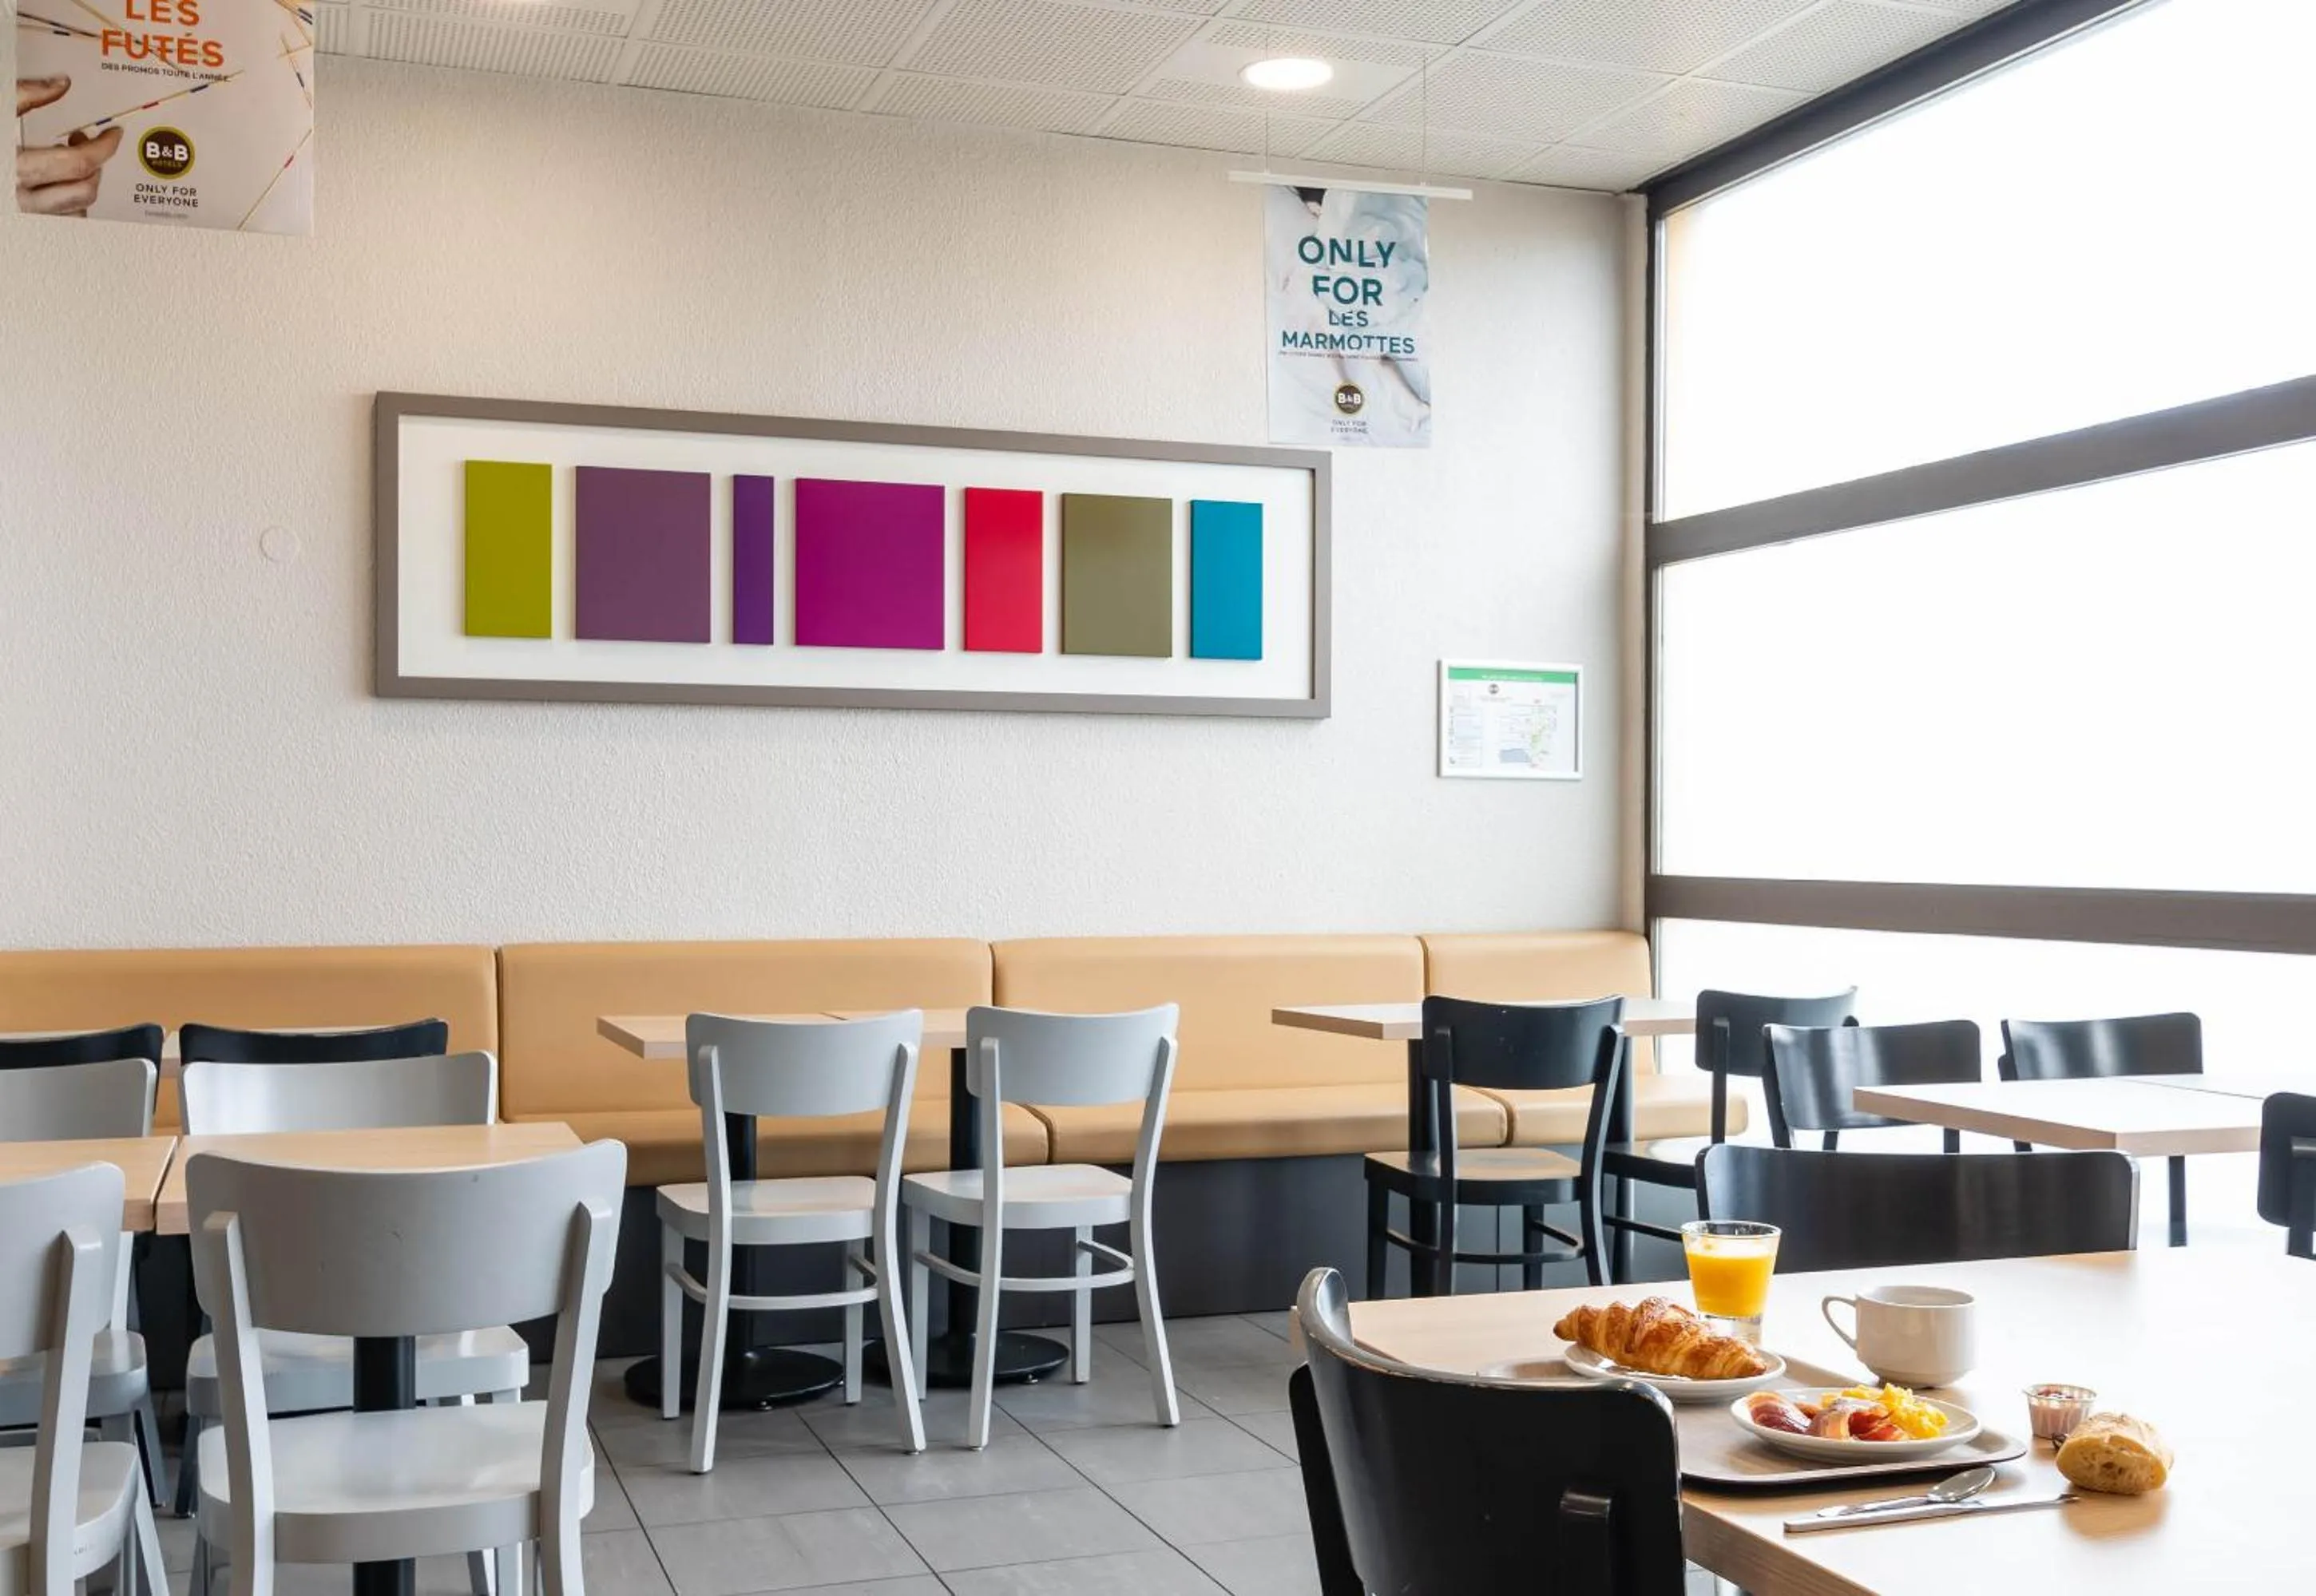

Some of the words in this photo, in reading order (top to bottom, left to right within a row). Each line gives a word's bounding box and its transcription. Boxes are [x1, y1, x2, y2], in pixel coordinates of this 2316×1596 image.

[126, 0, 200, 26] LES
[101, 28, 224, 68] FUTÉS
[101, 62, 119, 71] DES
[121, 65, 160, 75] PROMOS
[162, 69, 190, 78] TOUTE
[146, 141, 188, 161] B&B
[135, 183, 168, 194] ONLY
[173, 186, 197, 196] FOR
[133, 194, 199, 208] EVERYONE
[1298, 236, 1397, 268] ONLY
[1312, 275, 1383, 306] FOR
[1329, 308, 1368, 327] LES
[1282, 330, 1415, 354] MARMOTTES
